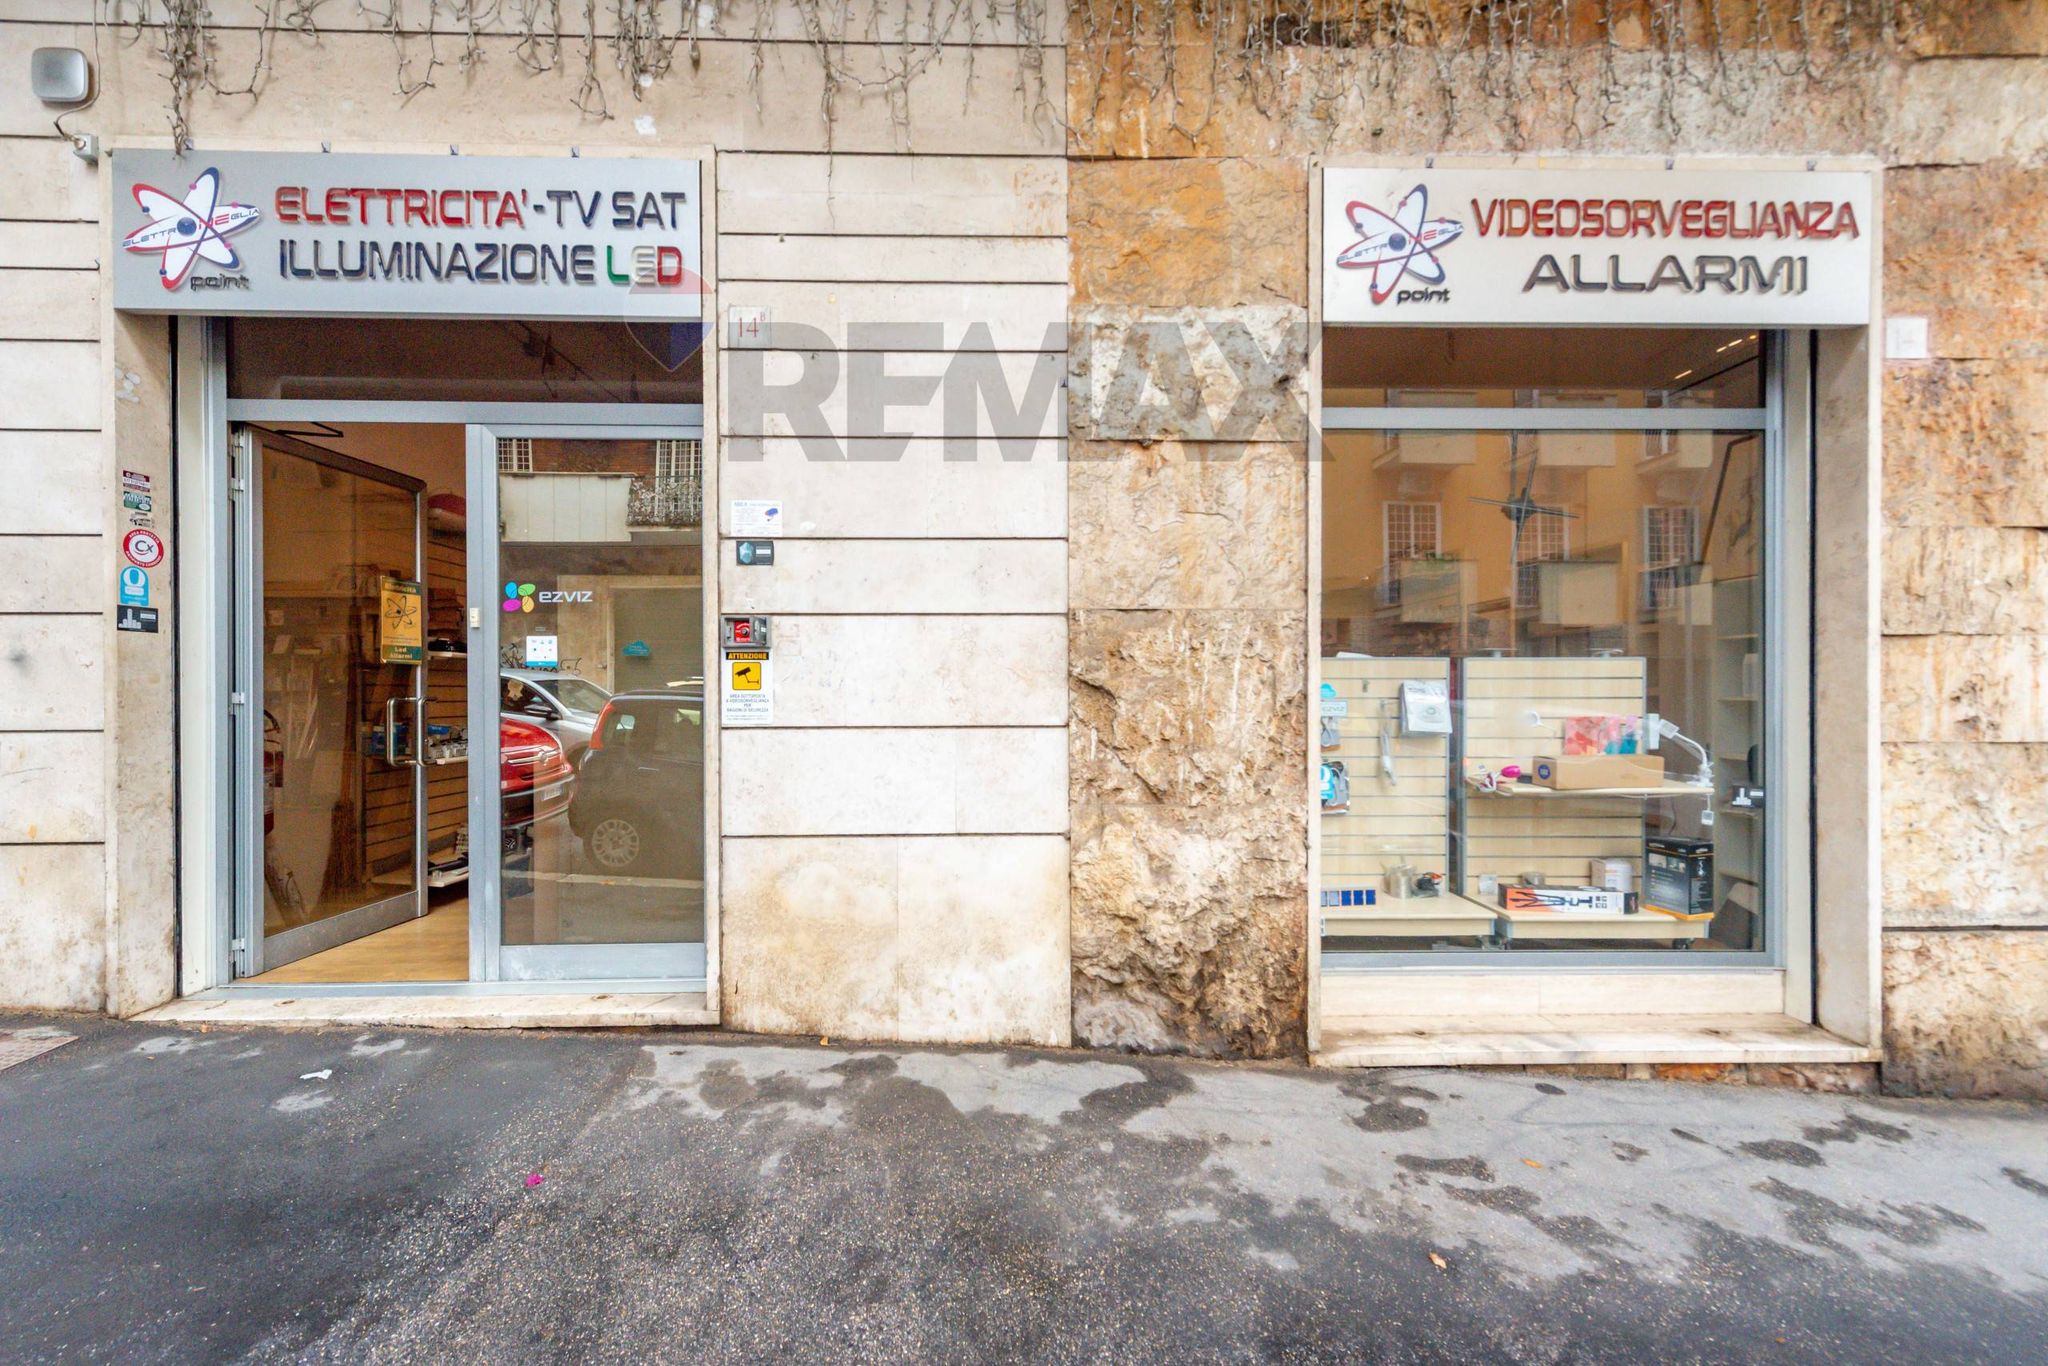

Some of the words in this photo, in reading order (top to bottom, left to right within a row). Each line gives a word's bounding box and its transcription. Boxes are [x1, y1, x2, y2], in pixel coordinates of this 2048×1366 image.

[612, 191, 686, 229] SAT
[1471, 198, 1860, 239] VIDEOSORVEGLIANZA
[279, 239, 595, 284] ILLUMINAZIONE
[606, 245, 683, 285] LED
[1522, 254, 1808, 294] ALLARMI
[190, 273, 249, 291] point
[1397, 287, 1451, 305] point
[737, 317, 760, 338] 14
[728, 652, 767, 660] ATTENZIONE
